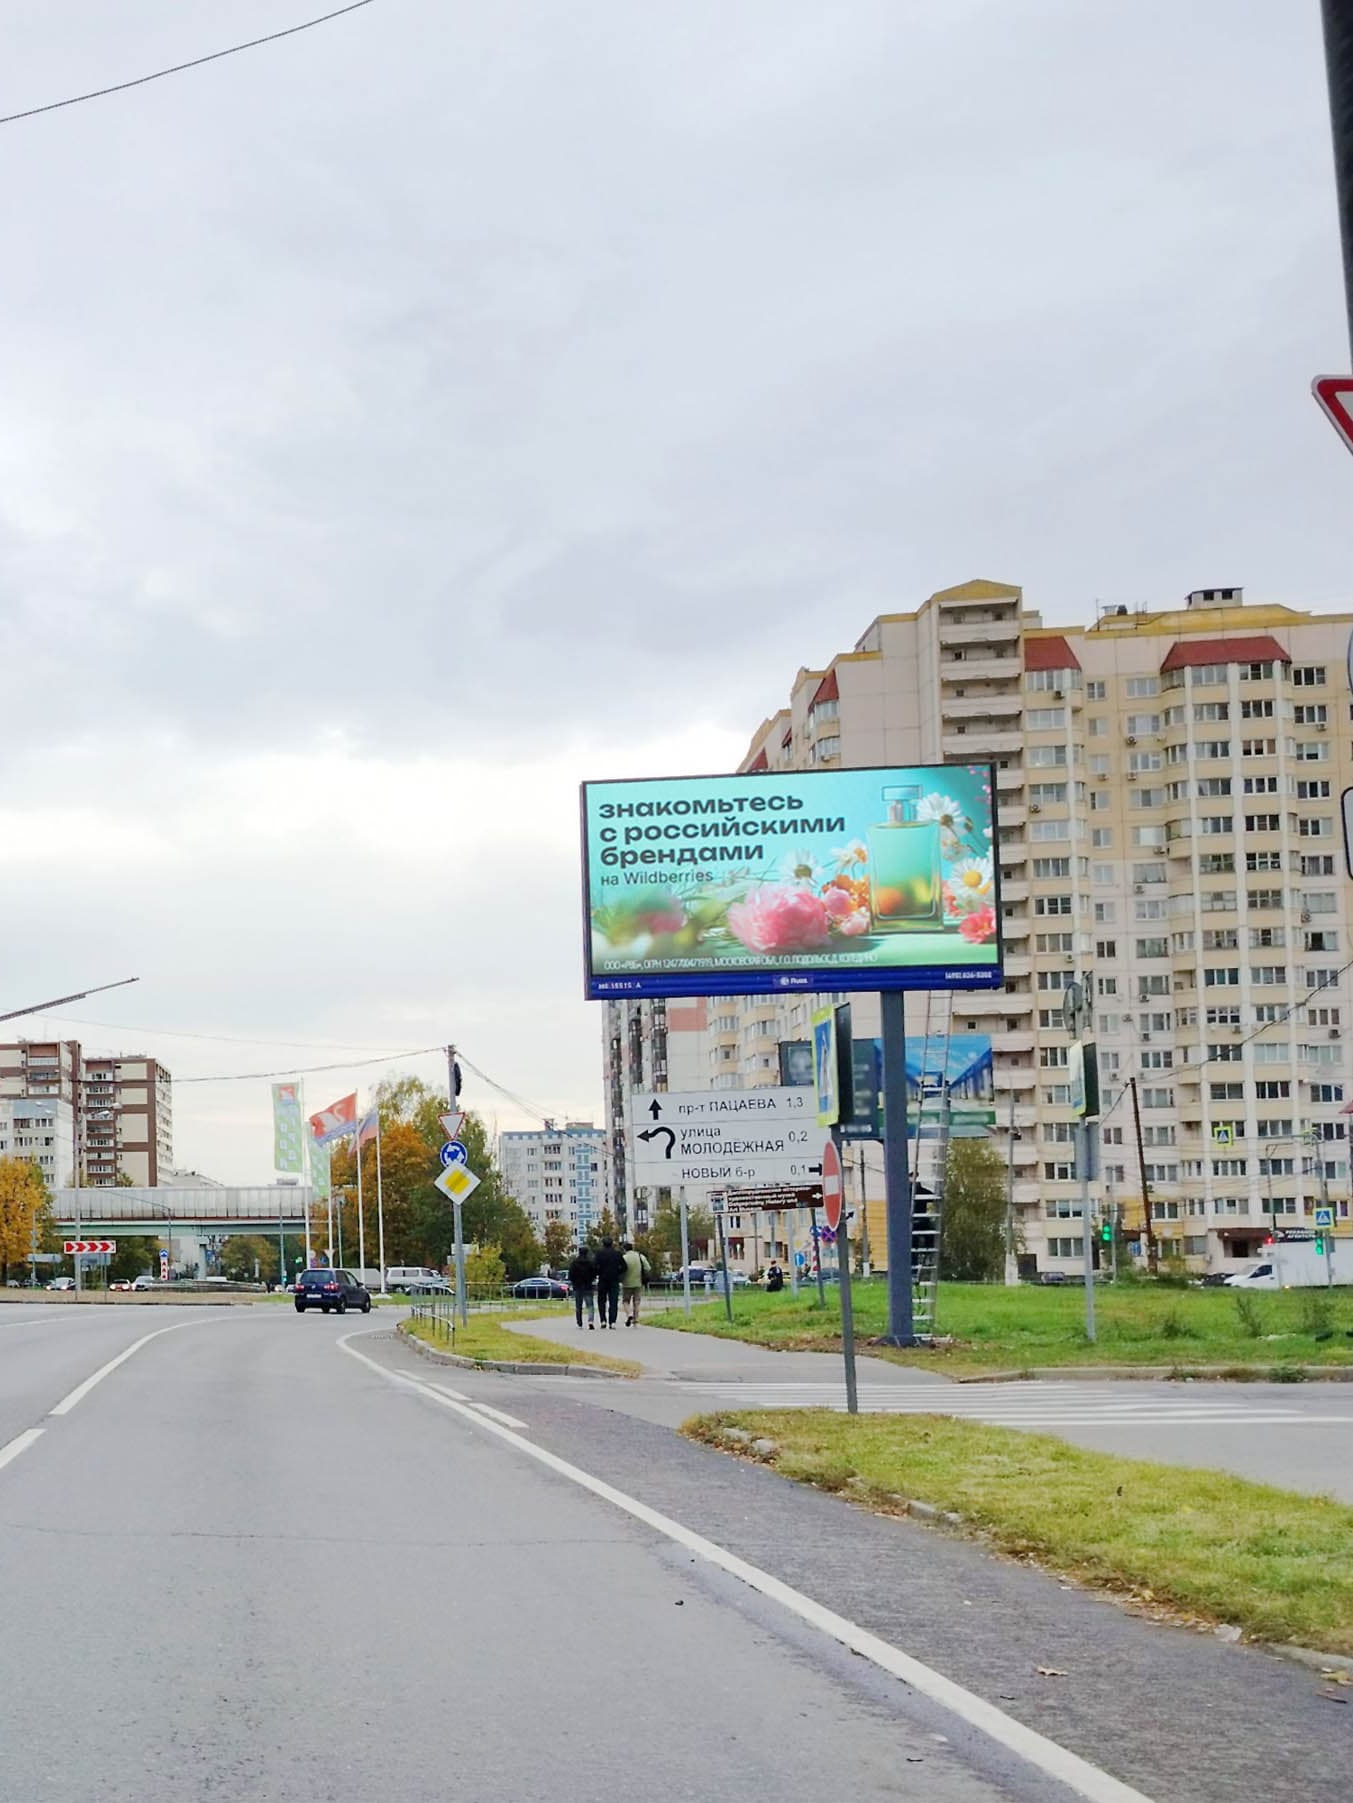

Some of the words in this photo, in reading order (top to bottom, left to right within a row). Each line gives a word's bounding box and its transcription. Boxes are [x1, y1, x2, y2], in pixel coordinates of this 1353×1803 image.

[599, 795, 804, 819] знакомьтесь
[600, 827, 617, 842] с
[624, 816, 845, 845] российскими
[601, 845, 764, 869] брендами
[601, 875, 619, 886] на
[623, 870, 714, 885] Wildberries
[678, 1104, 705, 1115] пр-т
[709, 1098, 777, 1112] ПАЦАЕВА
[786, 1096, 804, 1108] 1,3
[680, 1127, 721, 1140] улица
[788, 1130, 808, 1144] 0,2
[680, 1140, 784, 1155] МОЛОДЕЖНАЯ
[735, 1166, 755, 1180] б-р
[790, 1164, 806, 1176] 0,1
